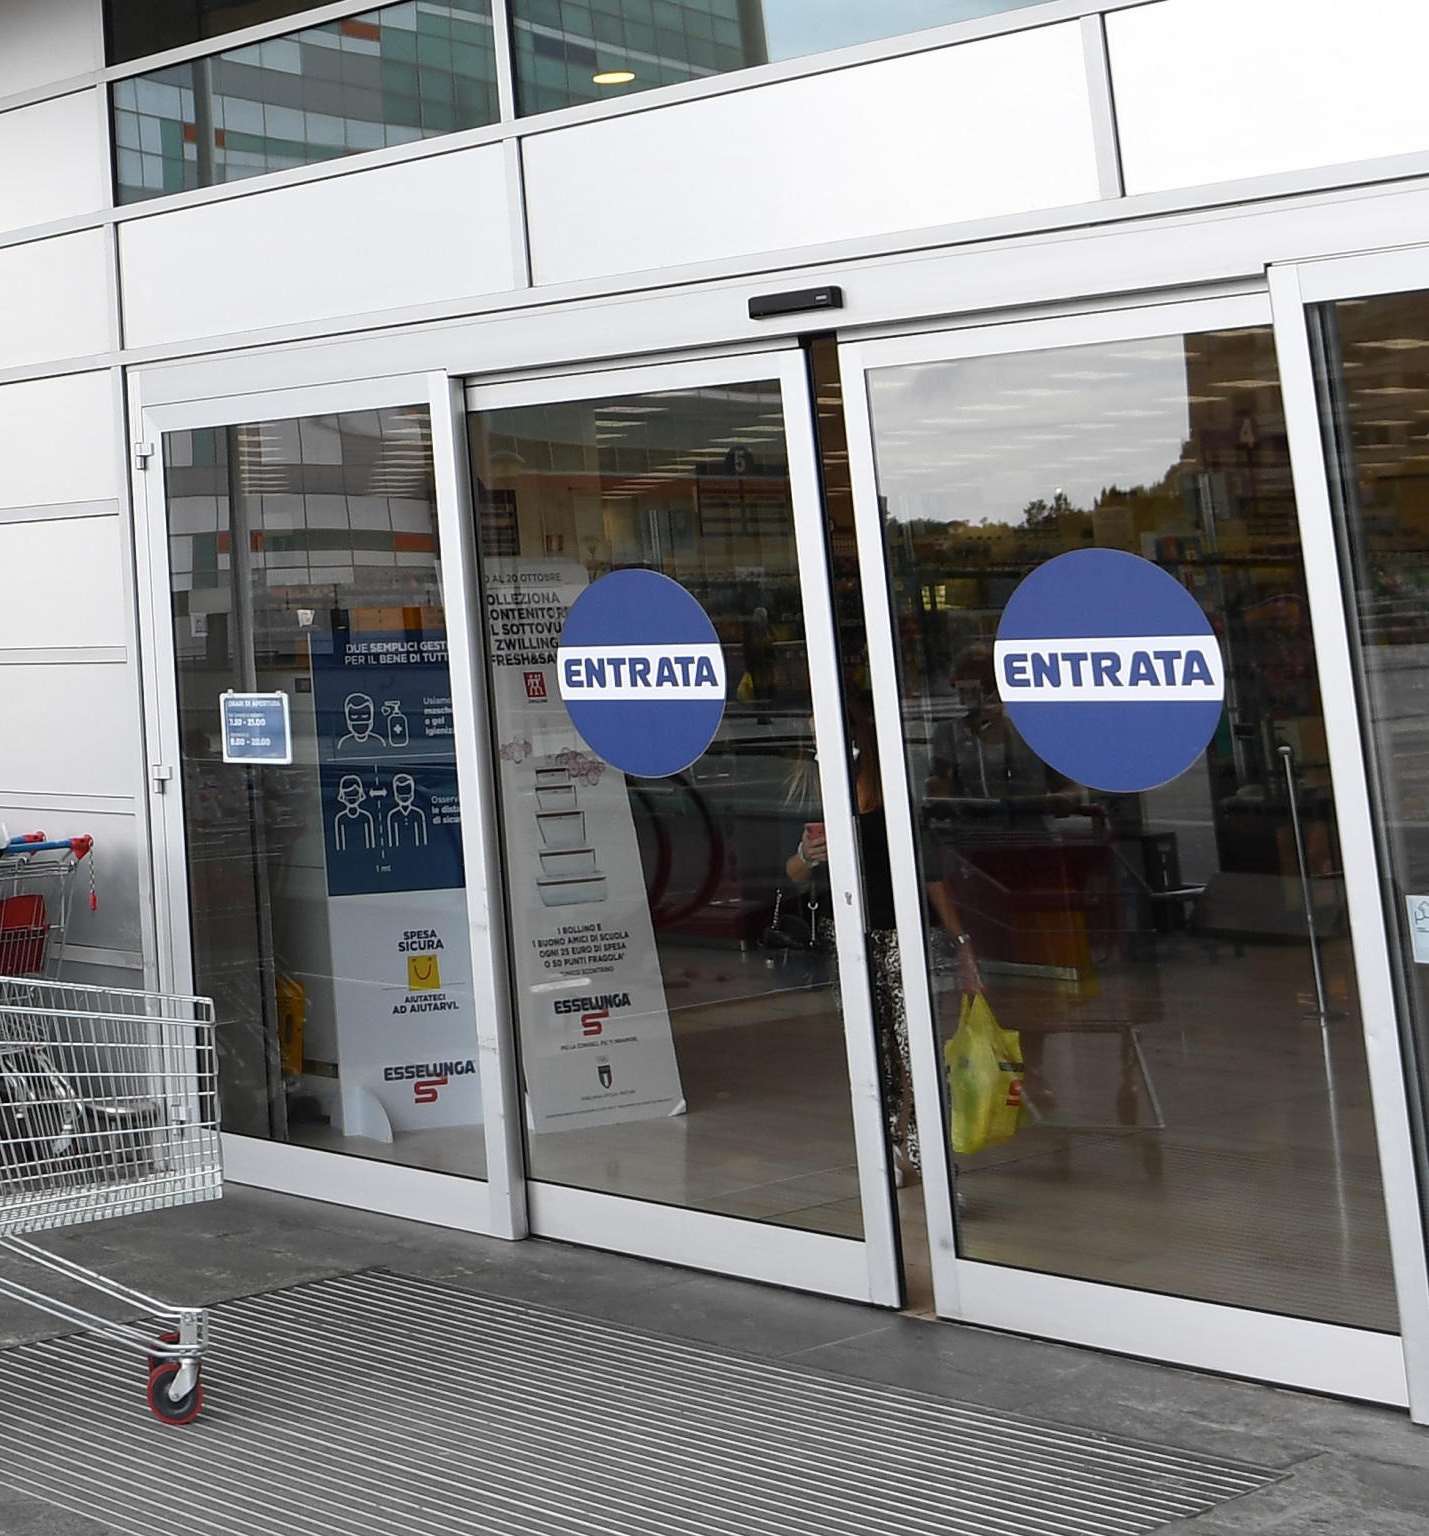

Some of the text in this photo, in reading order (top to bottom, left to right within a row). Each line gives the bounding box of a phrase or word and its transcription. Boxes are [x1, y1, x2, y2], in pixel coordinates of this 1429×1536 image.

[506, 574, 518, 582] 20
[486, 591, 561, 606] OLLEZIONA
[502, 621, 562, 636] SOTTOVU
[346, 640, 447, 654] DUE SEMPLICI GEST
[495, 636, 559, 652] ZWILLING
[345, 651, 449, 665] PER IL BENE DI TUTT
[564, 656, 719, 689] ENTRATA
[1004, 649, 1215, 689] ENTRATA
[403, 929, 437, 941] SPESA
[563, 923, 595, 934] BOLLINO
[398, 939, 444, 952] SICURA
[538, 937, 566, 947] BUONO
[567, 935, 589, 944] AMICI
[590, 934, 599, 942] DI
[600, 931, 630, 941] SCUOLA
[539, 949, 559, 958] OGNI
[571, 945, 592, 954] EURO
[593, 944, 602, 952] DI
[603, 941, 627, 951] SPESA
[564, 956, 586, 965] PUNTI
[404, 993, 446, 1004] AIUTATECI
[554, 992, 631, 1015] ESSELUNGA
[392, 1006, 408, 1015] AD
[383, 1060, 476, 1082] ESSELUNGA
